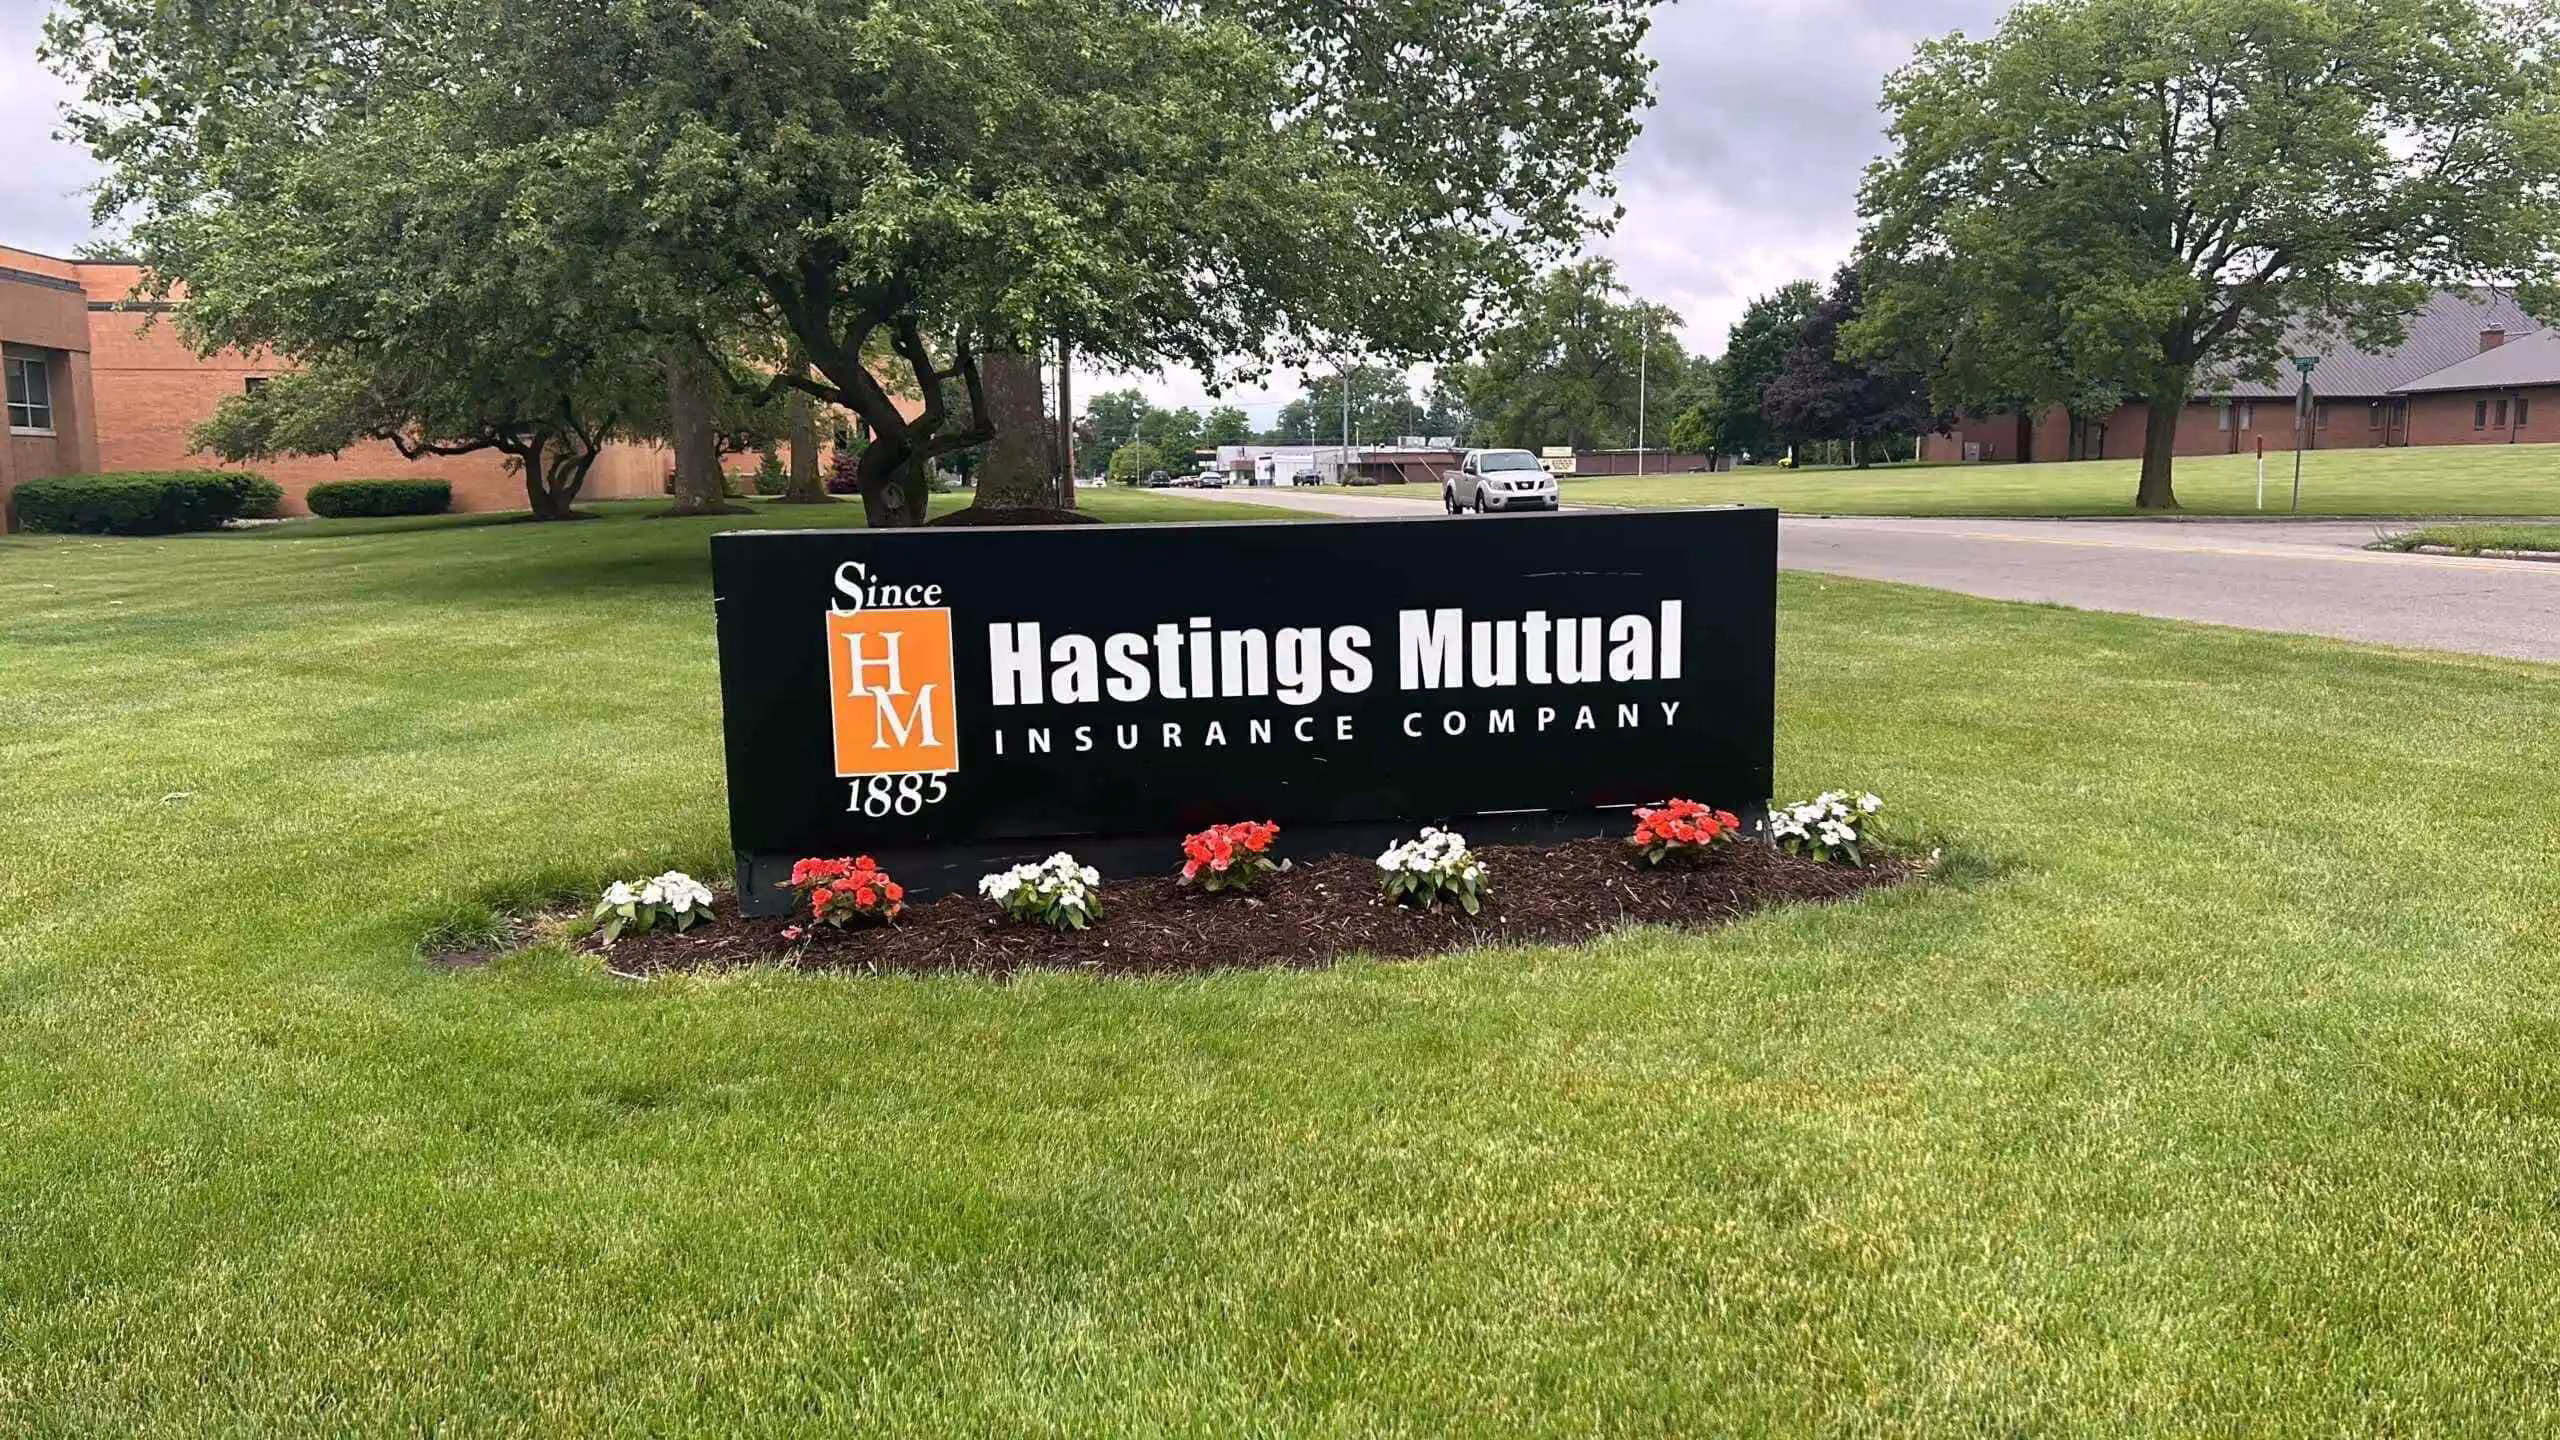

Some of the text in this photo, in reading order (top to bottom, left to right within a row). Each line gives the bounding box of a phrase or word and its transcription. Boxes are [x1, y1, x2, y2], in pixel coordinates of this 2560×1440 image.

[831, 560, 943, 618] Since
[988, 599, 1682, 706] Hastings Mutual
[995, 701, 1680, 755] INSURANCE COMPANY
[845, 772, 948, 818] 1885
